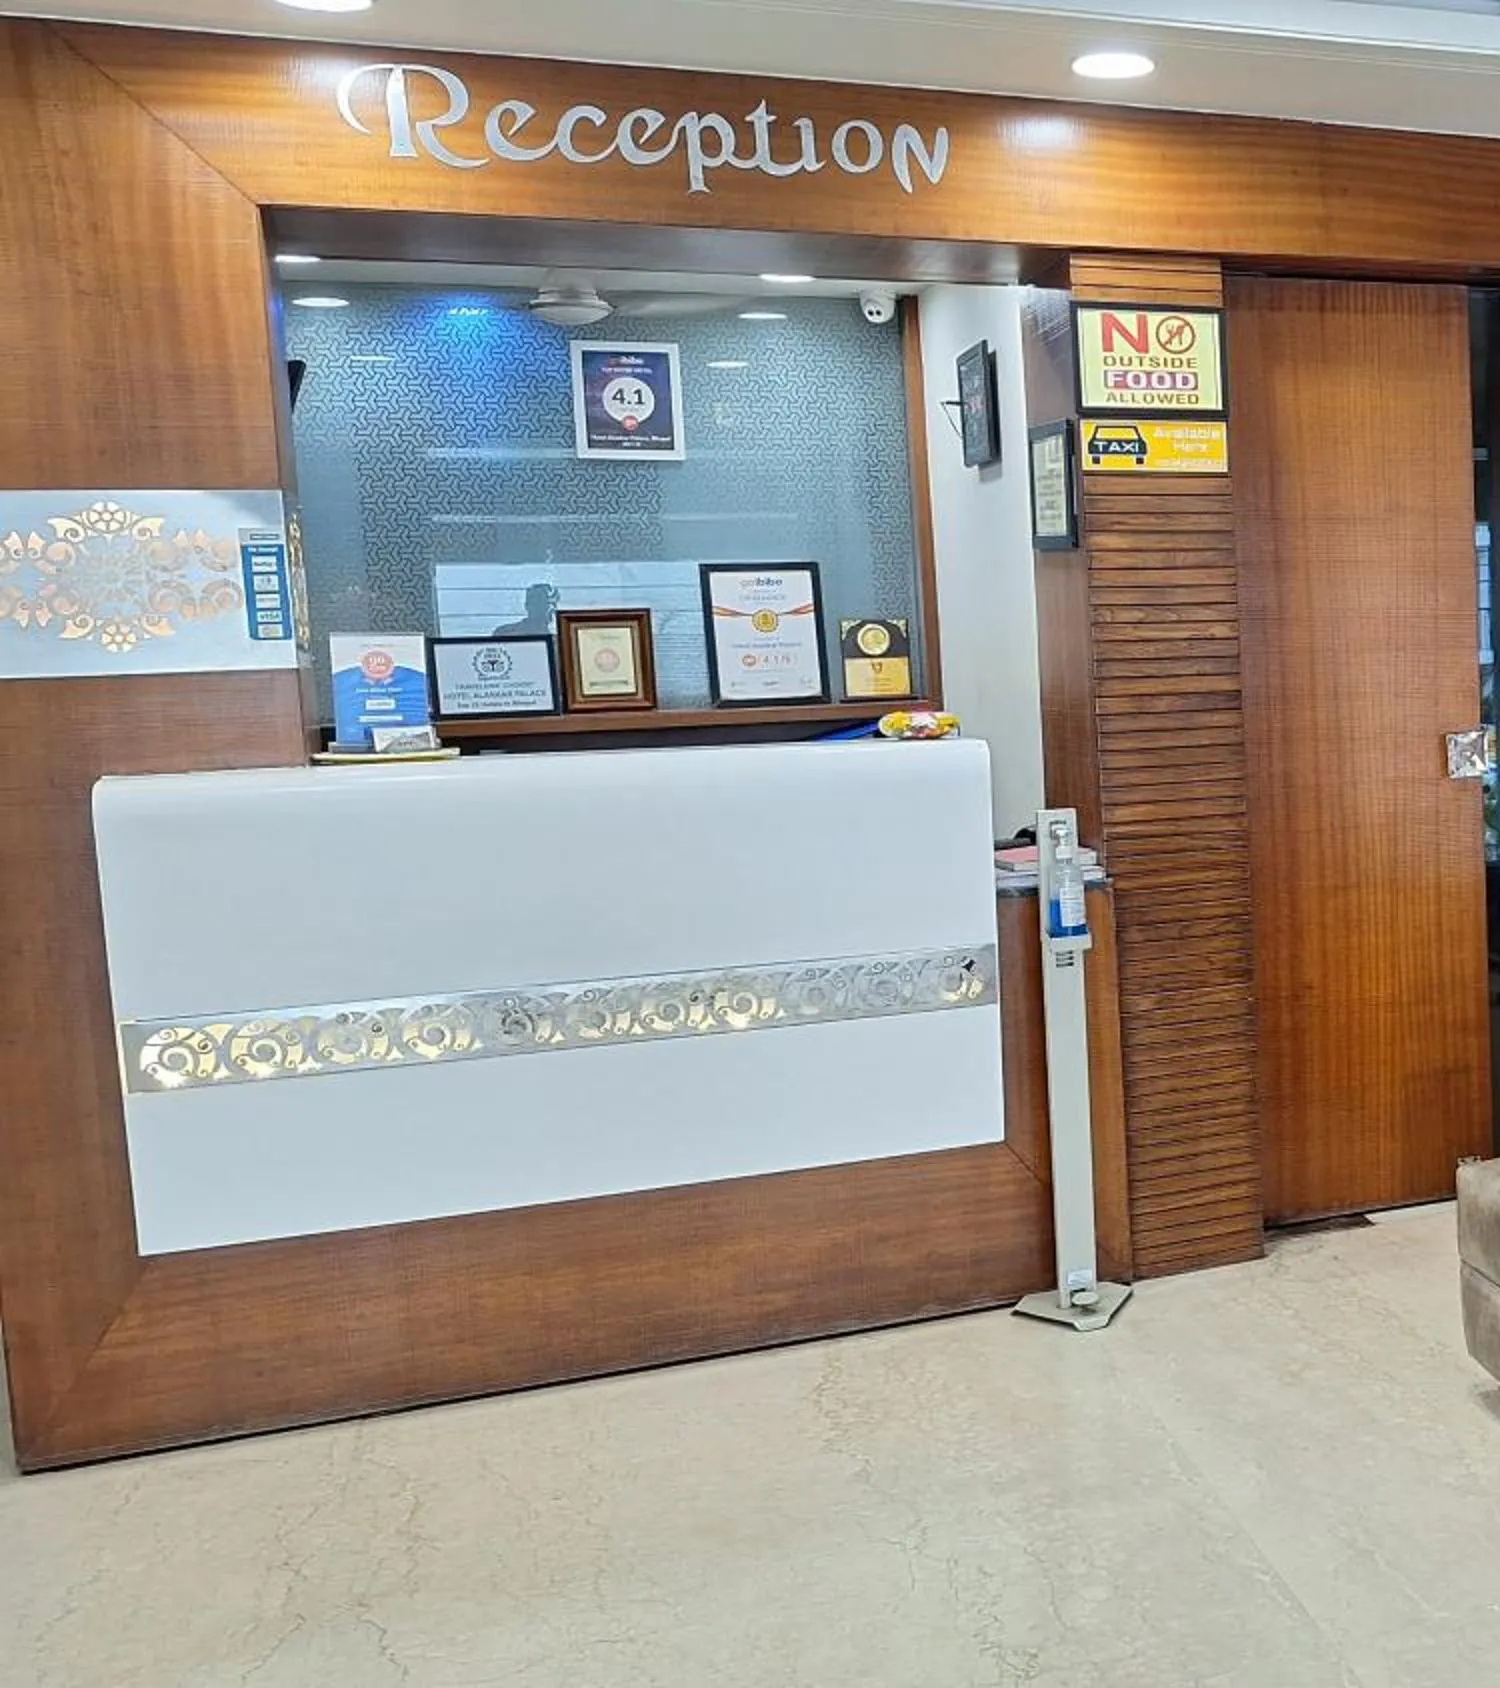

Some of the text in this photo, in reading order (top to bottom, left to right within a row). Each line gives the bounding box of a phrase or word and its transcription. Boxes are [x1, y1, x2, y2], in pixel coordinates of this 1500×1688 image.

[1103, 355, 1198, 369] OUTSIDE
[1106, 371, 1197, 390] FOOD
[611, 387, 646, 405] 4.1
[1105, 392, 1200, 405] ALLOWED
[1094, 441, 1139, 453] TAXI
